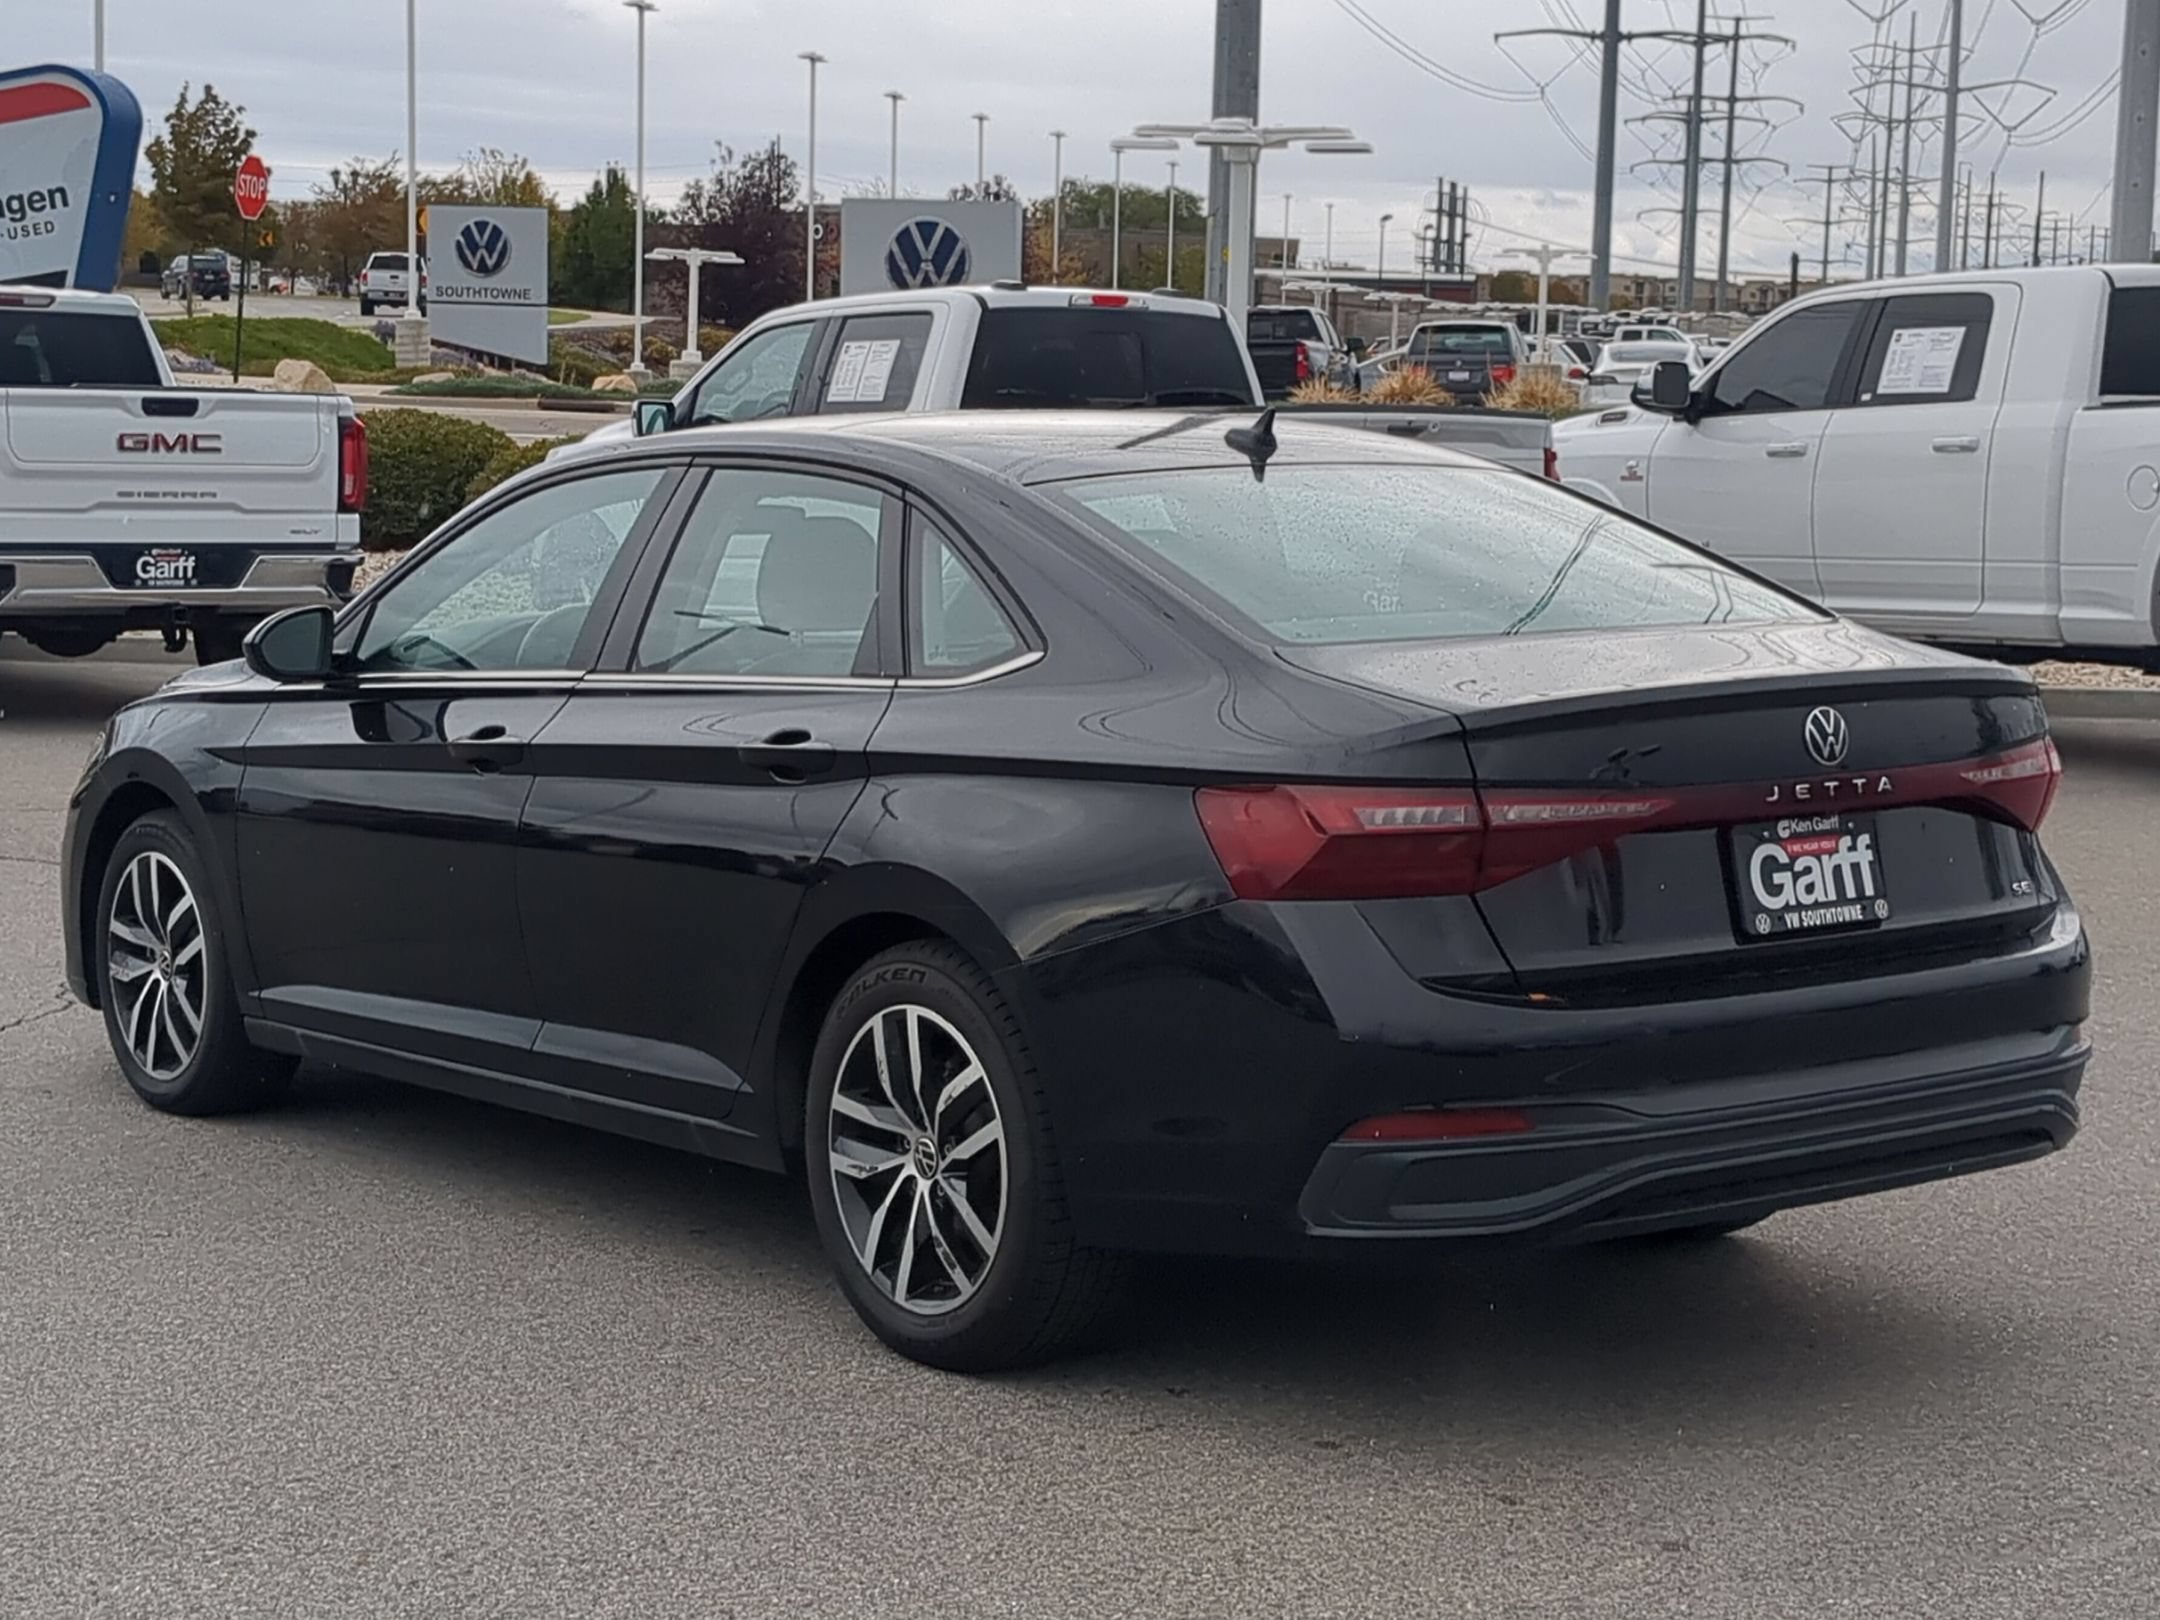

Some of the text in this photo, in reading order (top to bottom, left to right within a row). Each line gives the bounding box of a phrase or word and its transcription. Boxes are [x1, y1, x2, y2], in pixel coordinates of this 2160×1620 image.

[238, 173, 266, 200] STOP
[0, 186, 69, 223] gen
[435, 285, 532, 300] SOUTHTOWNE
[117, 432, 222, 453] GMC
[136, 555, 196, 579] Garff
[1765, 775, 1892, 802] JETTA
[1790, 815, 1840, 833] Ken Garff
[1750, 833, 1875, 910] Garff
[2012, 881, 2031, 895] SE
[1801, 904, 1863, 927] SOUTHTOWNE
